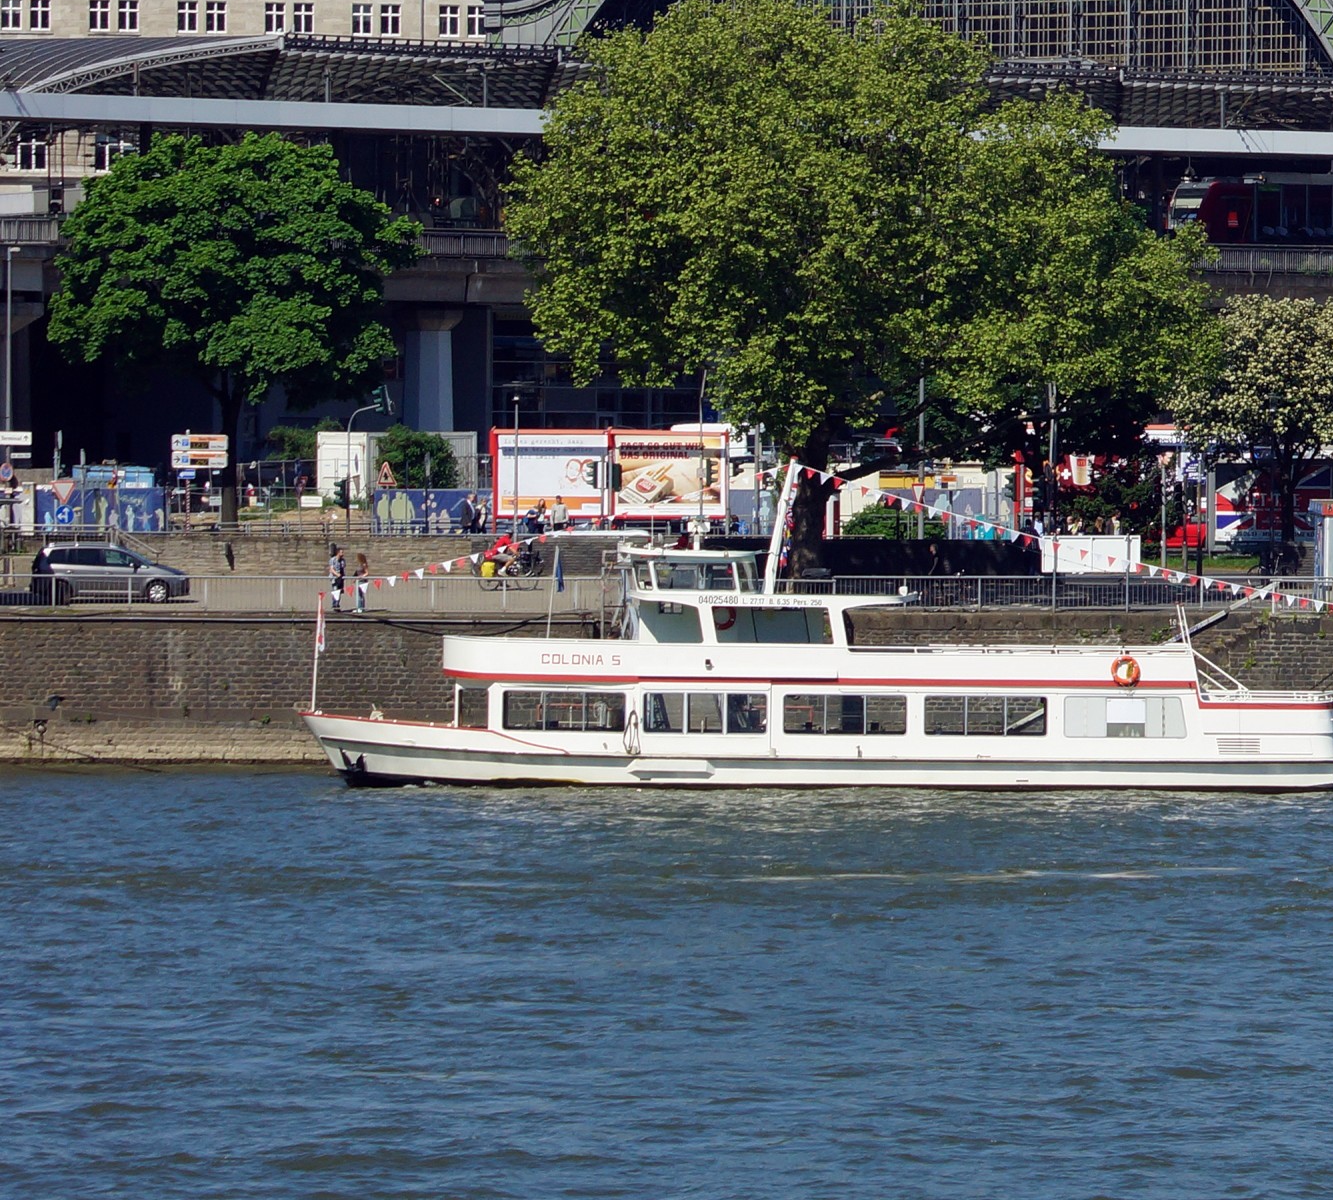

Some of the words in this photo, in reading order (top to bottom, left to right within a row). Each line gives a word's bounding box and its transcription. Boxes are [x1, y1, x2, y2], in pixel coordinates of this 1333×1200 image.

[663, 442, 682, 451] GUT
[620, 451, 639, 460] DAS
[642, 451, 690, 460] ORIGINAL
[698, 595, 739, 605] 04025480
[541, 653, 604, 666] COLONIA
